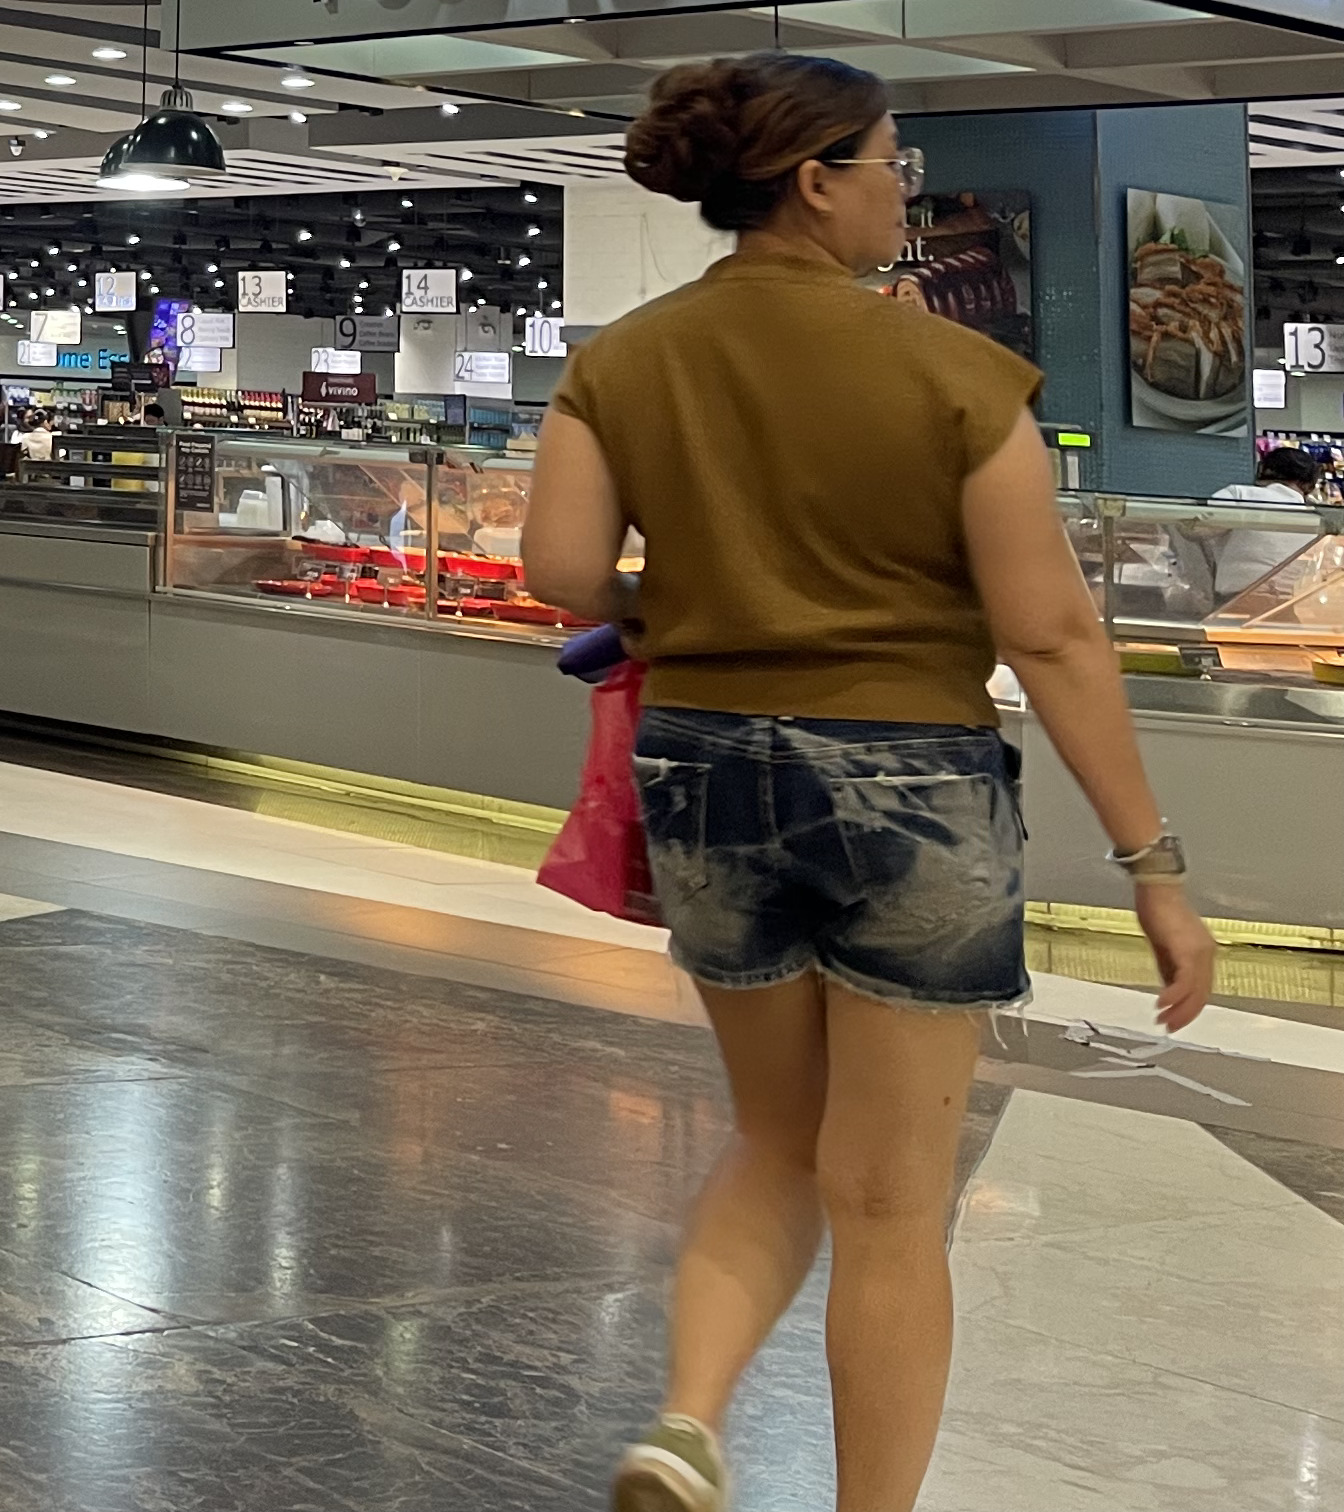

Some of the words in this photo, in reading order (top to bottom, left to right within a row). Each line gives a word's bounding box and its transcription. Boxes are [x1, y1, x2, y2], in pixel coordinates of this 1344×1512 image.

[97, 276, 115, 296] 12
[241, 275, 263, 297] 13
[405, 273, 430, 296] 14
[240, 296, 285, 308] CASHIER
[403, 295, 455, 308] CASHIER
[34, 312, 48, 341] 7
[180, 314, 195, 345] 8
[339, 316, 357, 348] 9
[528, 319, 552, 354] 10
[56, 351, 90, 369] me
[1288, 326, 1326, 370] 13
[455, 353, 474, 380] 24
